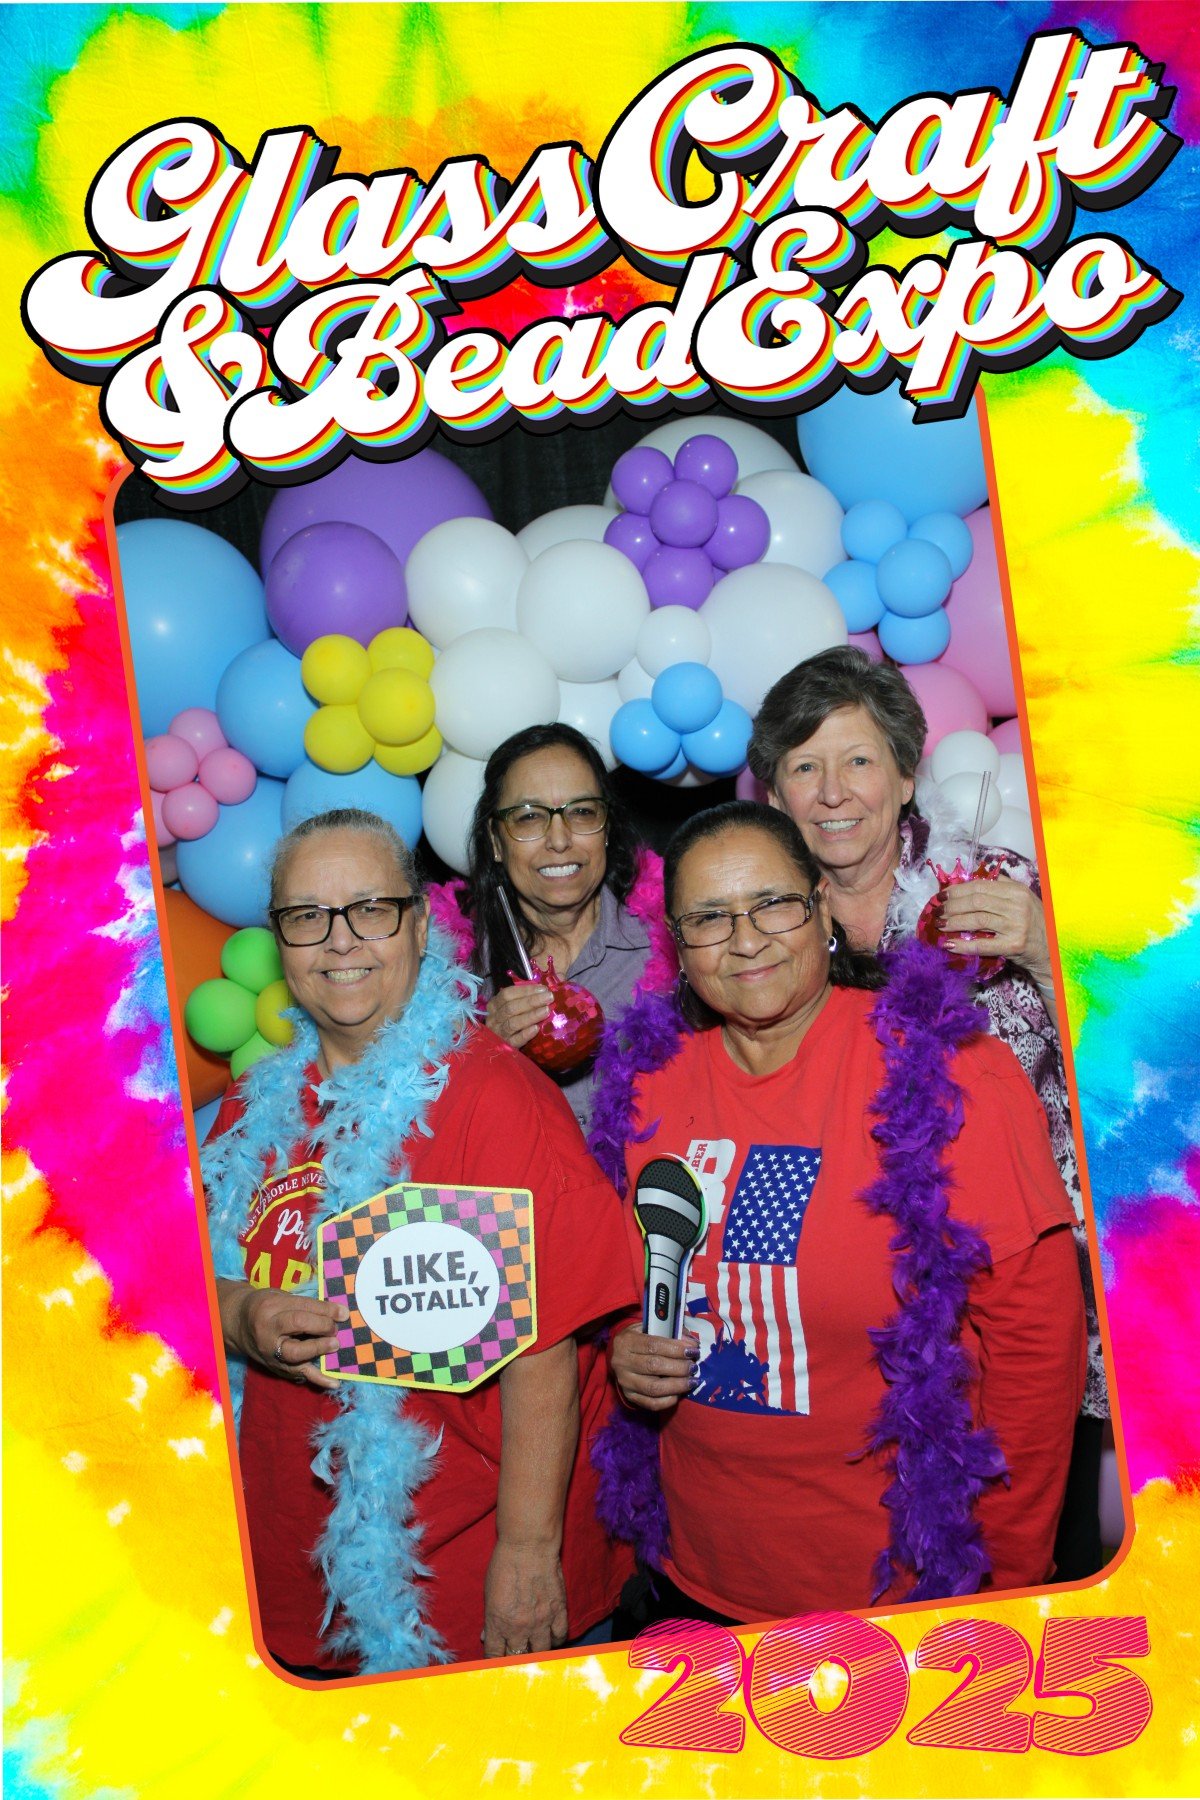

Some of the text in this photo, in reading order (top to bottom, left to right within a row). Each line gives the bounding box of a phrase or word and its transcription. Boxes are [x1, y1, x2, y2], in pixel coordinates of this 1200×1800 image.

[261, 1178, 299, 1213] PEOPLE
[383, 1250, 479, 1287] LIKE,
[375, 1285, 490, 1315] TOTALLY
